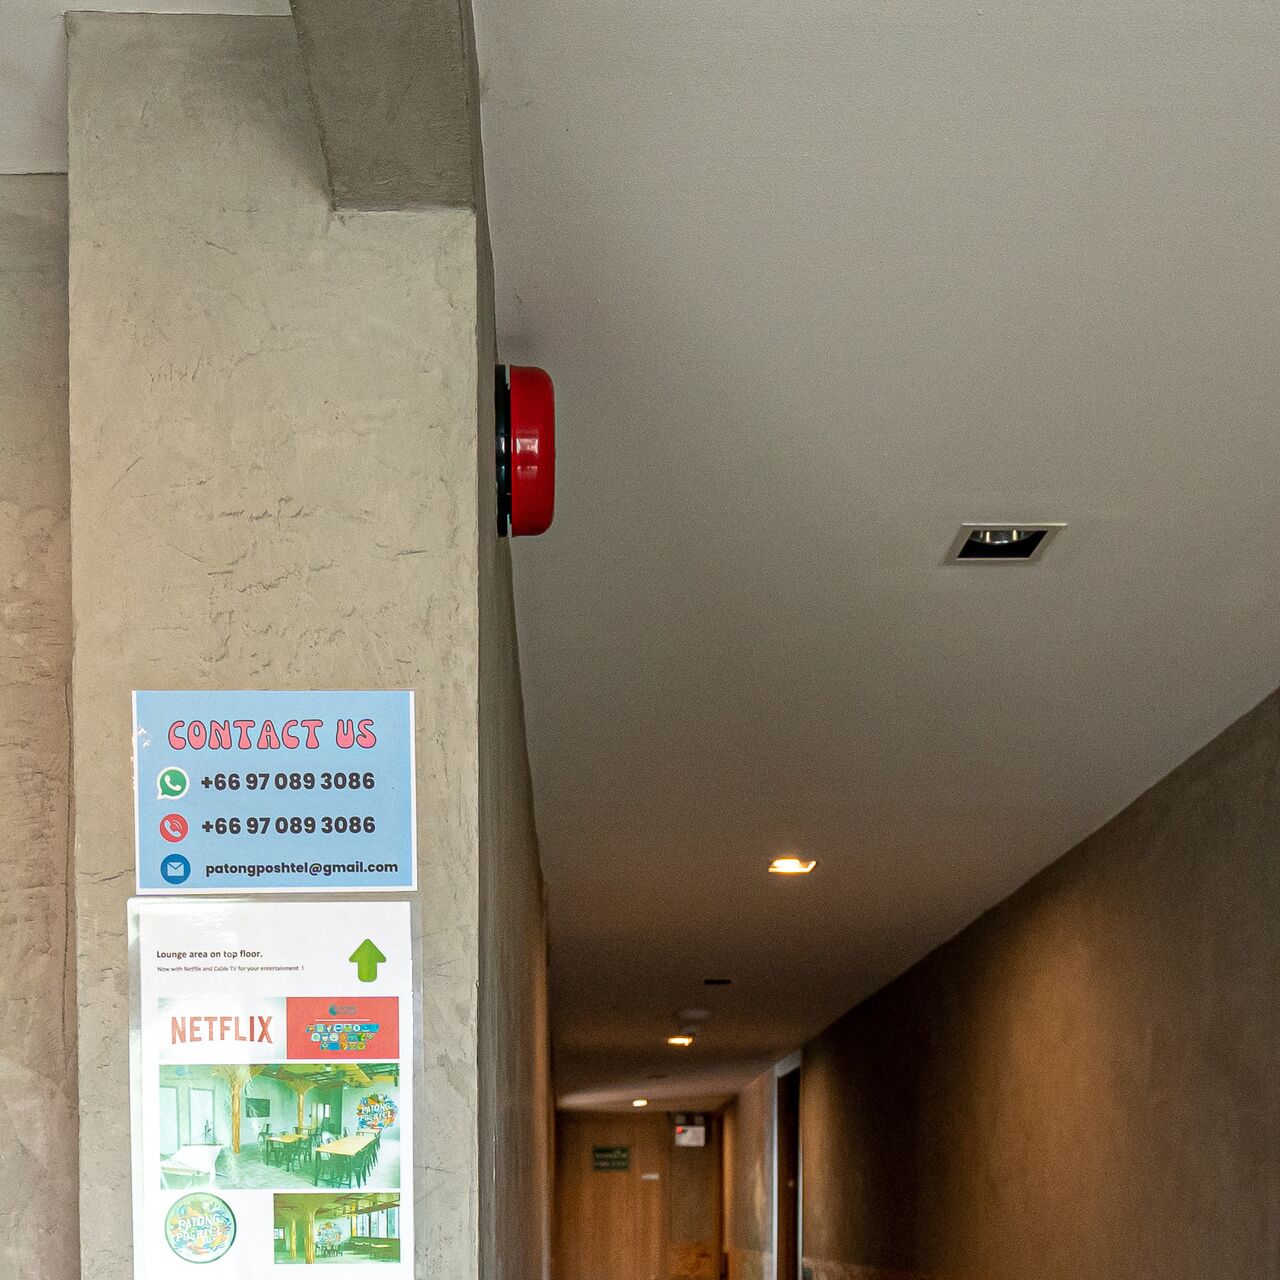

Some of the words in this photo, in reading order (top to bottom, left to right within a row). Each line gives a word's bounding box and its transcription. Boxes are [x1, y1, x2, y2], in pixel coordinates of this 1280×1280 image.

[168, 718, 324, 750] CONTACT
[335, 718, 378, 749] US
[201, 772, 241, 791] +66
[246, 773, 270, 790] 97
[274, 772, 316, 790] 089
[320, 771, 376, 790] 3086
[201, 817, 241, 835] +66
[246, 817, 271, 834] 97
[274, 816, 316, 834] 089
[321, 815, 376, 834] 3086
[205, 860, 399, 877] patongposhtel@gmail.com
[156, 950, 187, 960] Lounge
[223, 950, 238, 960] top
[240, 949, 264, 958] floor.
[171, 1015, 274, 1045] NETFLIX
